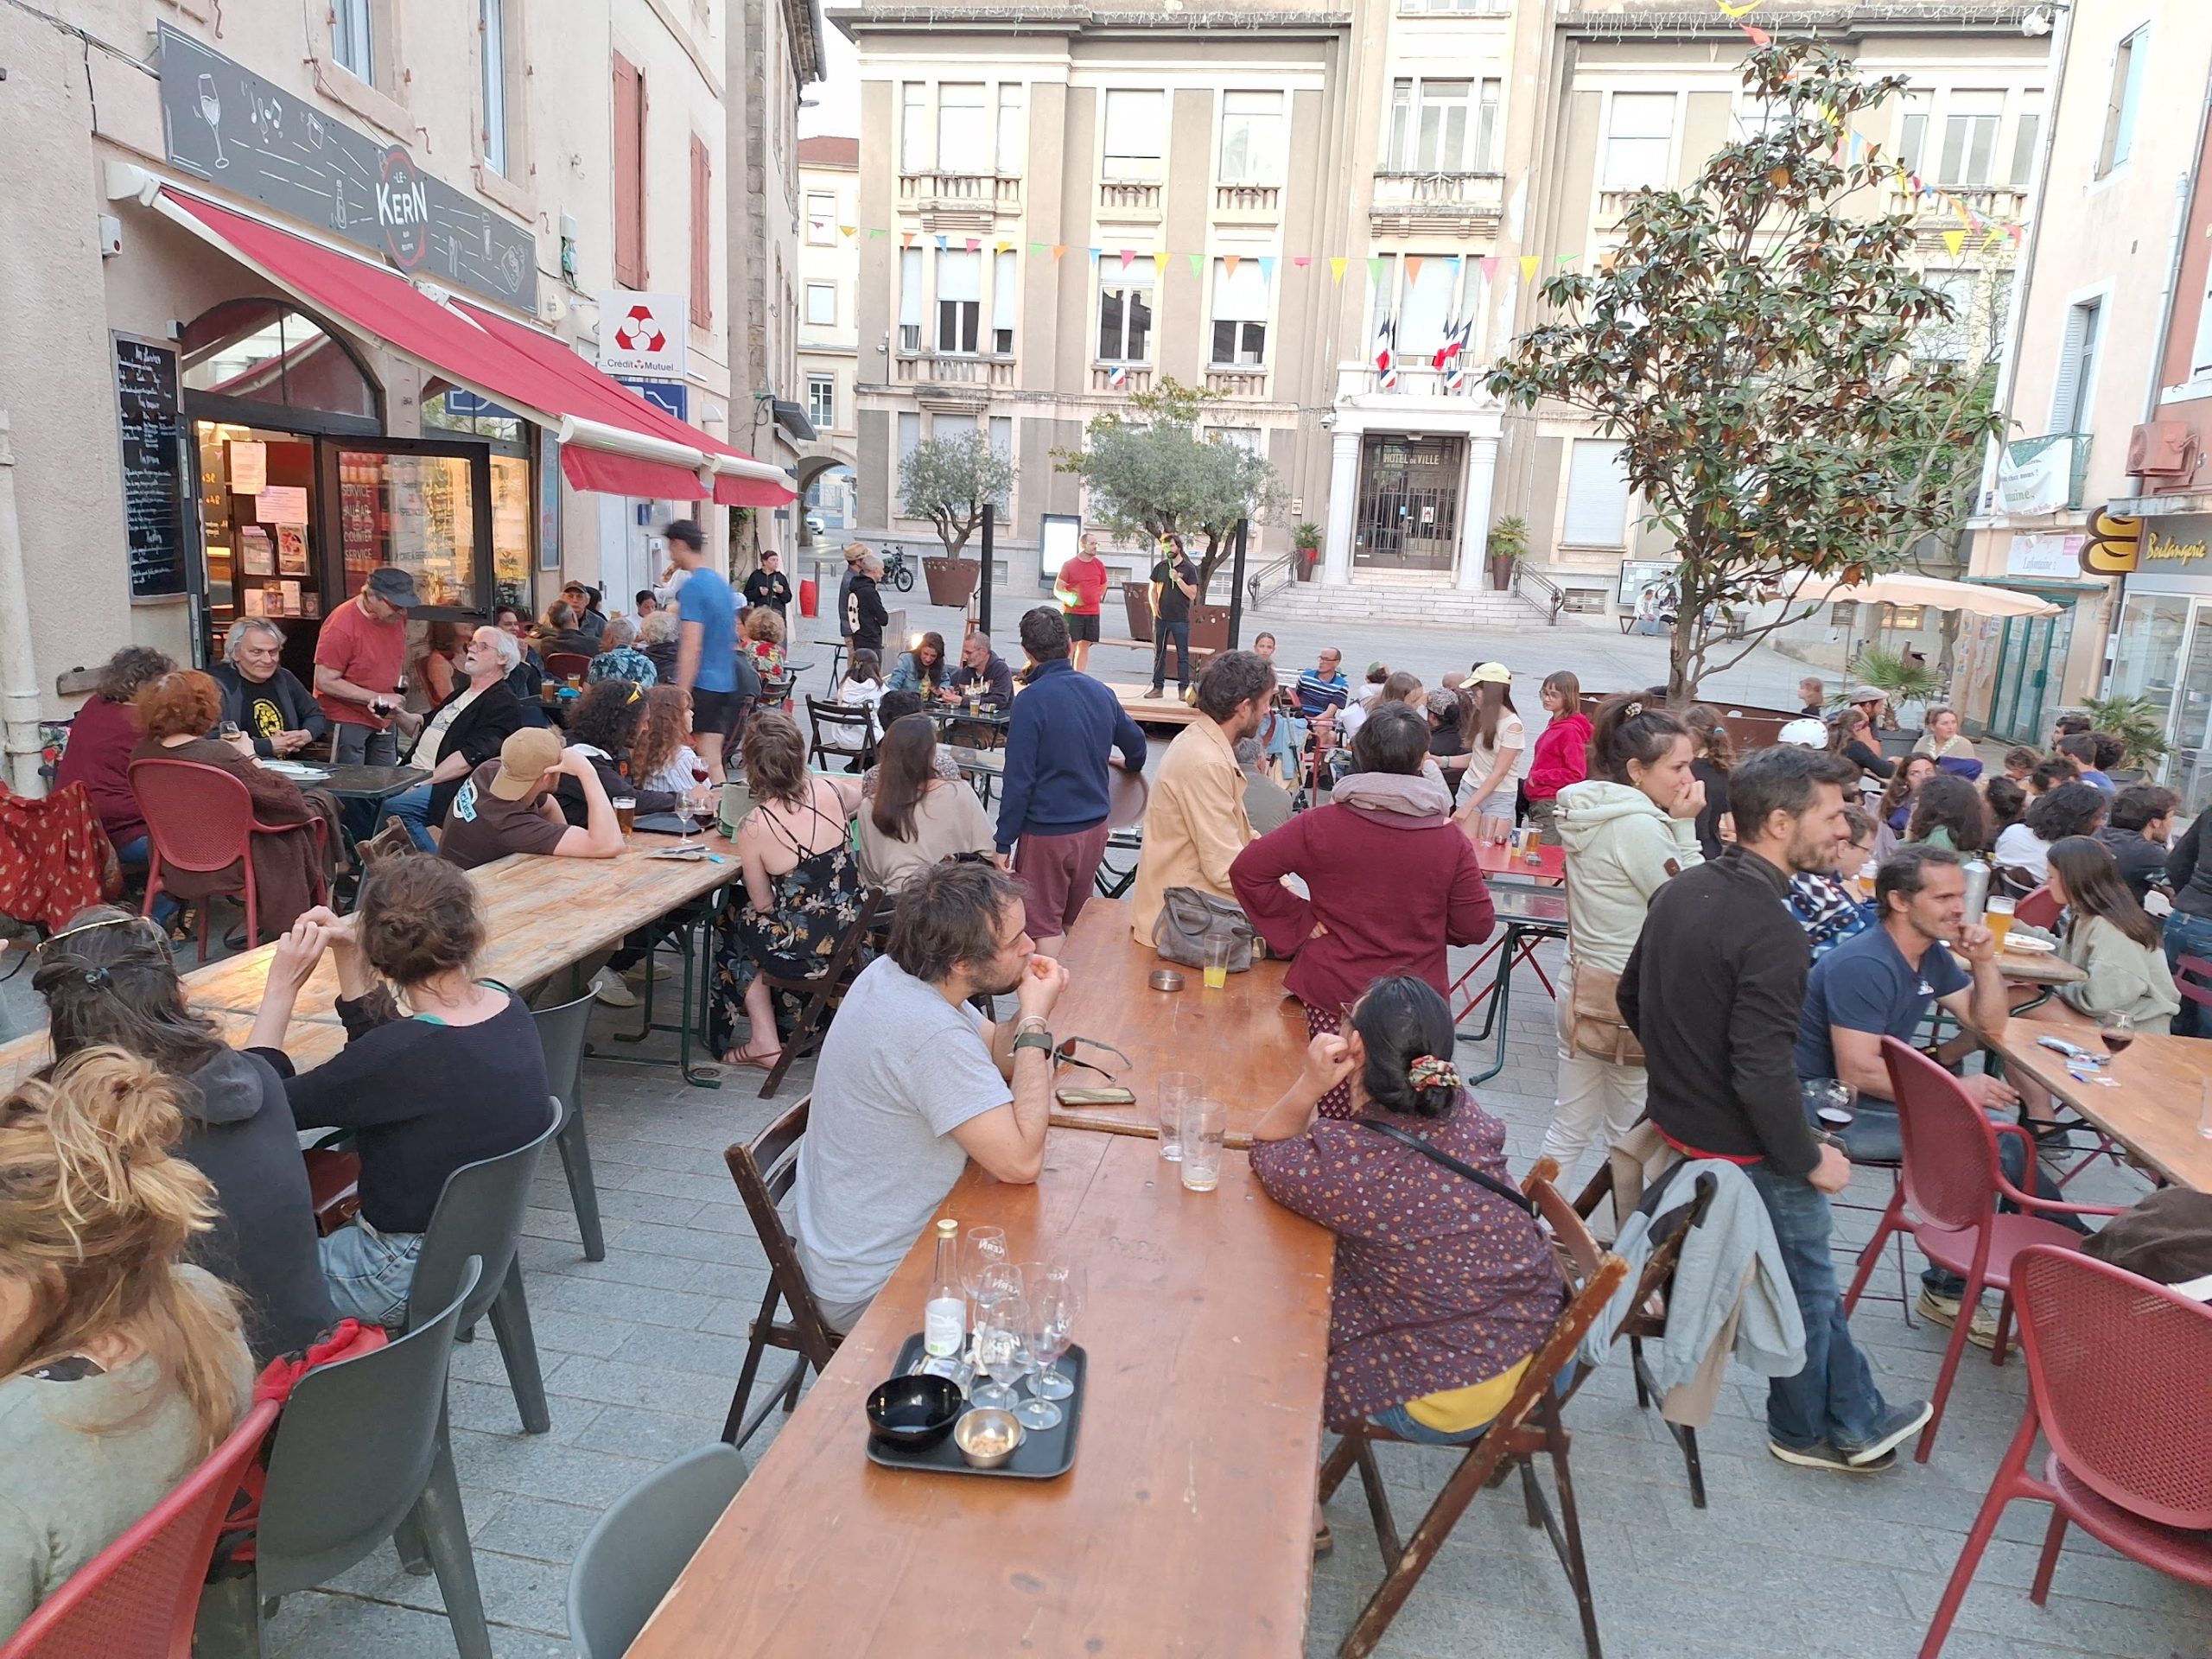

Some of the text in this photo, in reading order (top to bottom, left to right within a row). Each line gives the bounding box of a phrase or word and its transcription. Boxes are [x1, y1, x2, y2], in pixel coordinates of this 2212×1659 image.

[397, 171, 404, 183] LE
[607, 358, 674, 372] Crédit Mutuel
[1417, 454, 1440, 465] VILLE
[341, 483, 372, 498] SERVICE
[343, 531, 372, 543] COUNTER
[345, 548, 372, 561] SERVICE
[2145, 532, 2205, 566] Boulangerie
